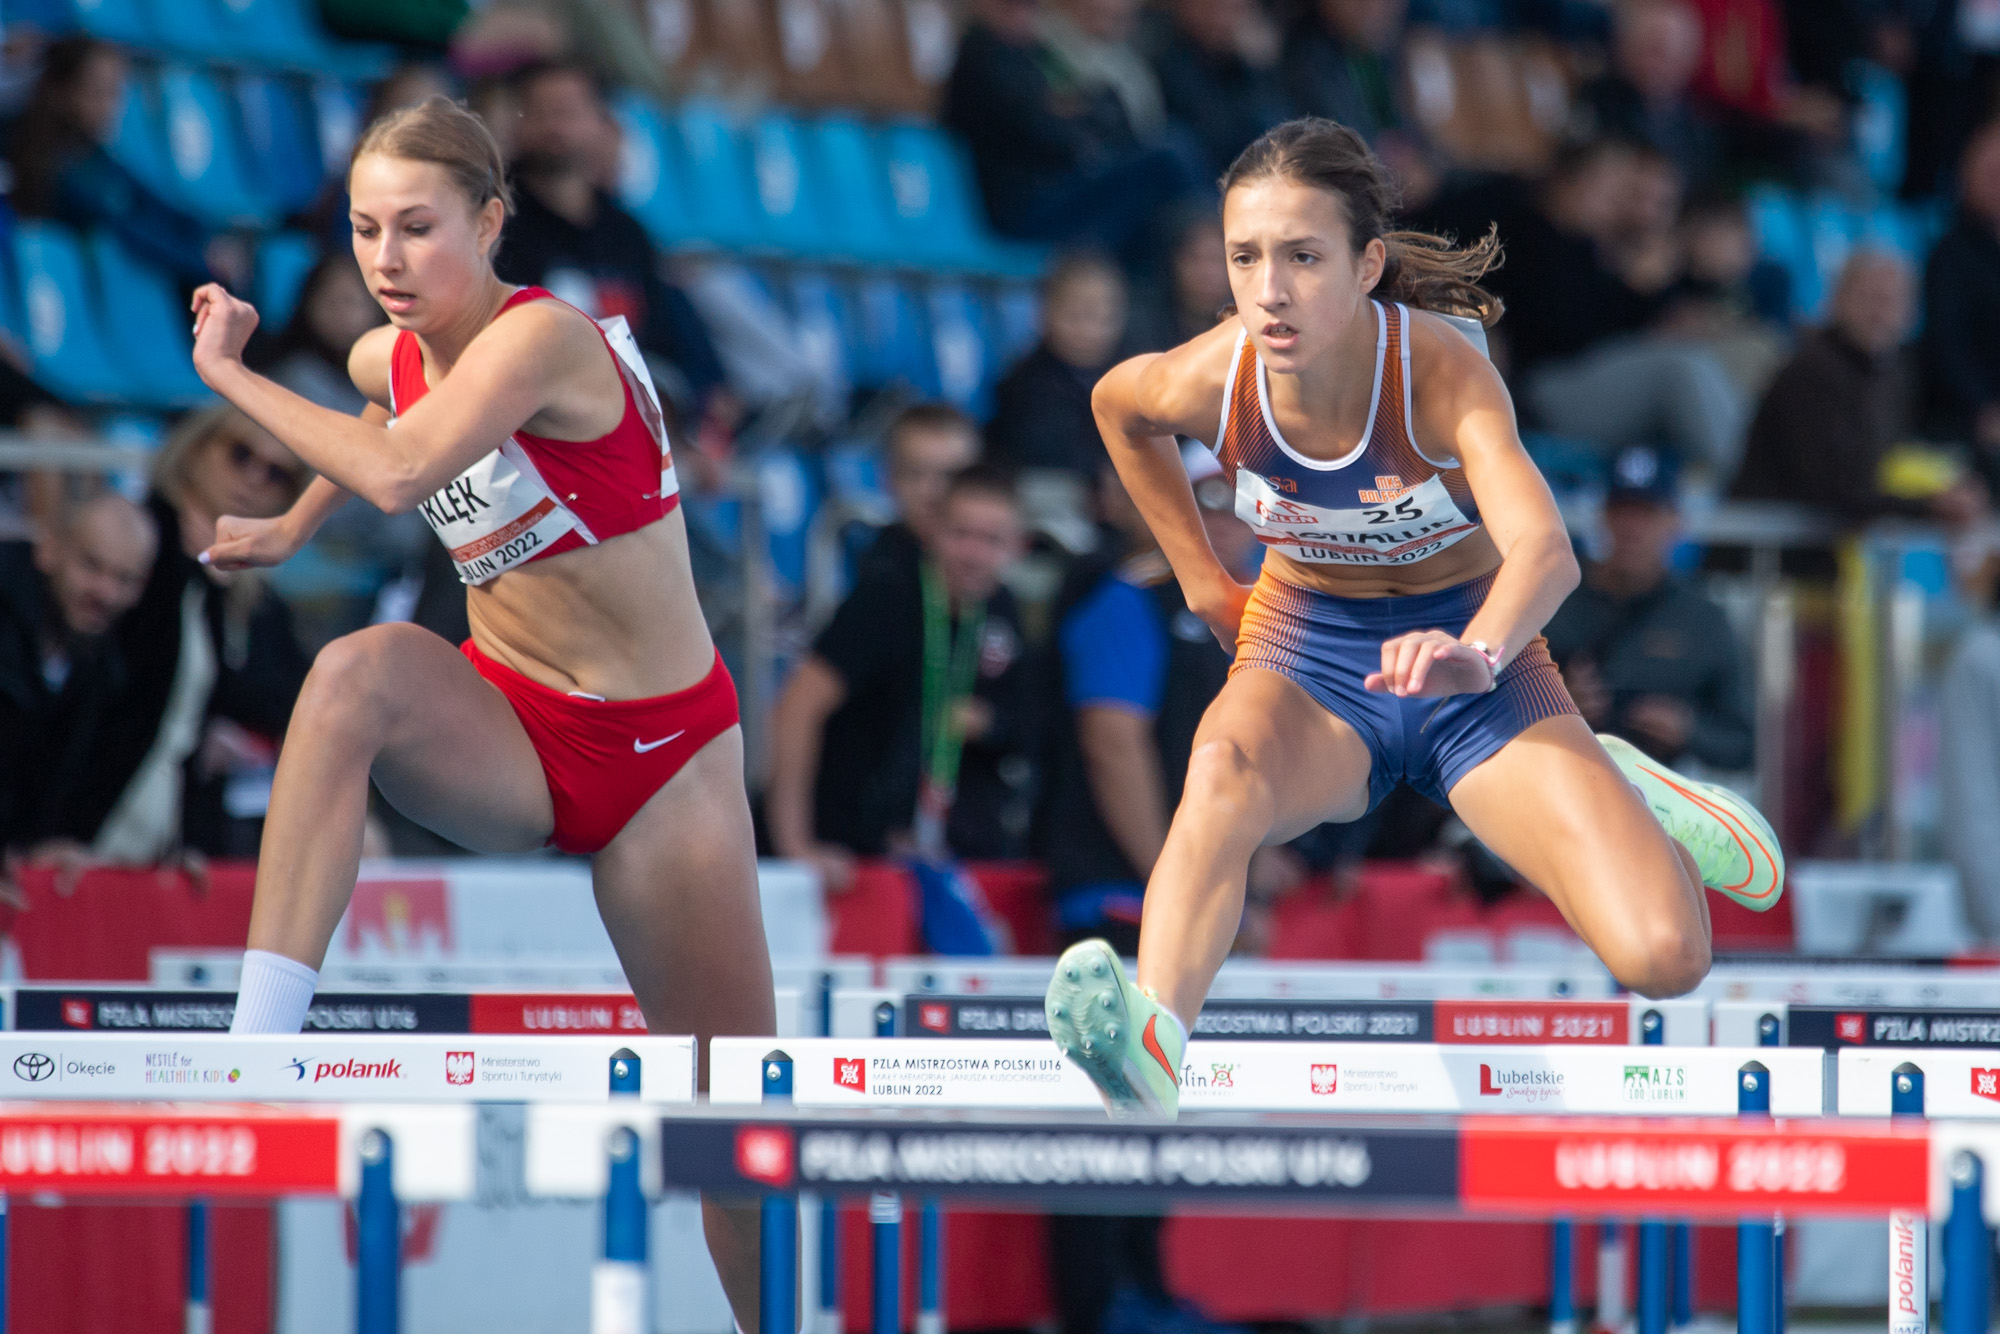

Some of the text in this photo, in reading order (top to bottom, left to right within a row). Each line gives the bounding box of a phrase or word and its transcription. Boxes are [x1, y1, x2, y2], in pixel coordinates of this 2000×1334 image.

[1375, 476, 1403, 489] MKS
[1259, 504, 1316, 524] ORLEN
[1362, 495, 1423, 525] 25
[495, 530, 543, 566] 2022
[1299, 547, 1379, 563] LUBLIN
[1387, 542, 1445, 563] 2022
[522, 1004, 613, 1029] LUBLIN
[1292, 1011, 1366, 1035] POLSKI
[1367, 1012, 1419, 1035] 2021
[1453, 1014, 1614, 1038] LUBLIN 2021
[1873, 1015, 1928, 1041] PZLA
[145, 1052, 192, 1067] NESTLÉ for
[481, 1057, 540, 1068] Ministerstwo
[873, 1058, 1062, 1071] PZLA MISTRZOSTWA POLSKI U16
[67, 1061, 116, 1077] Okęcie
[145, 1070, 226, 1083] HEALTHIER KIDS
[314, 1058, 402, 1083] polanik
[481, 1070, 513, 1082] Sportu
[520, 1071, 562, 1083] Turystyki
[1343, 1069, 1398, 1080] Ministerstwo
[950, 1073, 988, 1083] JANUSZA
[872, 1085, 943, 1096] LUBLIN 2022
[1343, 1082, 1371, 1094] Sportu
[1379, 1083, 1418, 1094] Turystyki
[1652, 1088, 1685, 1100] LUBLIN
